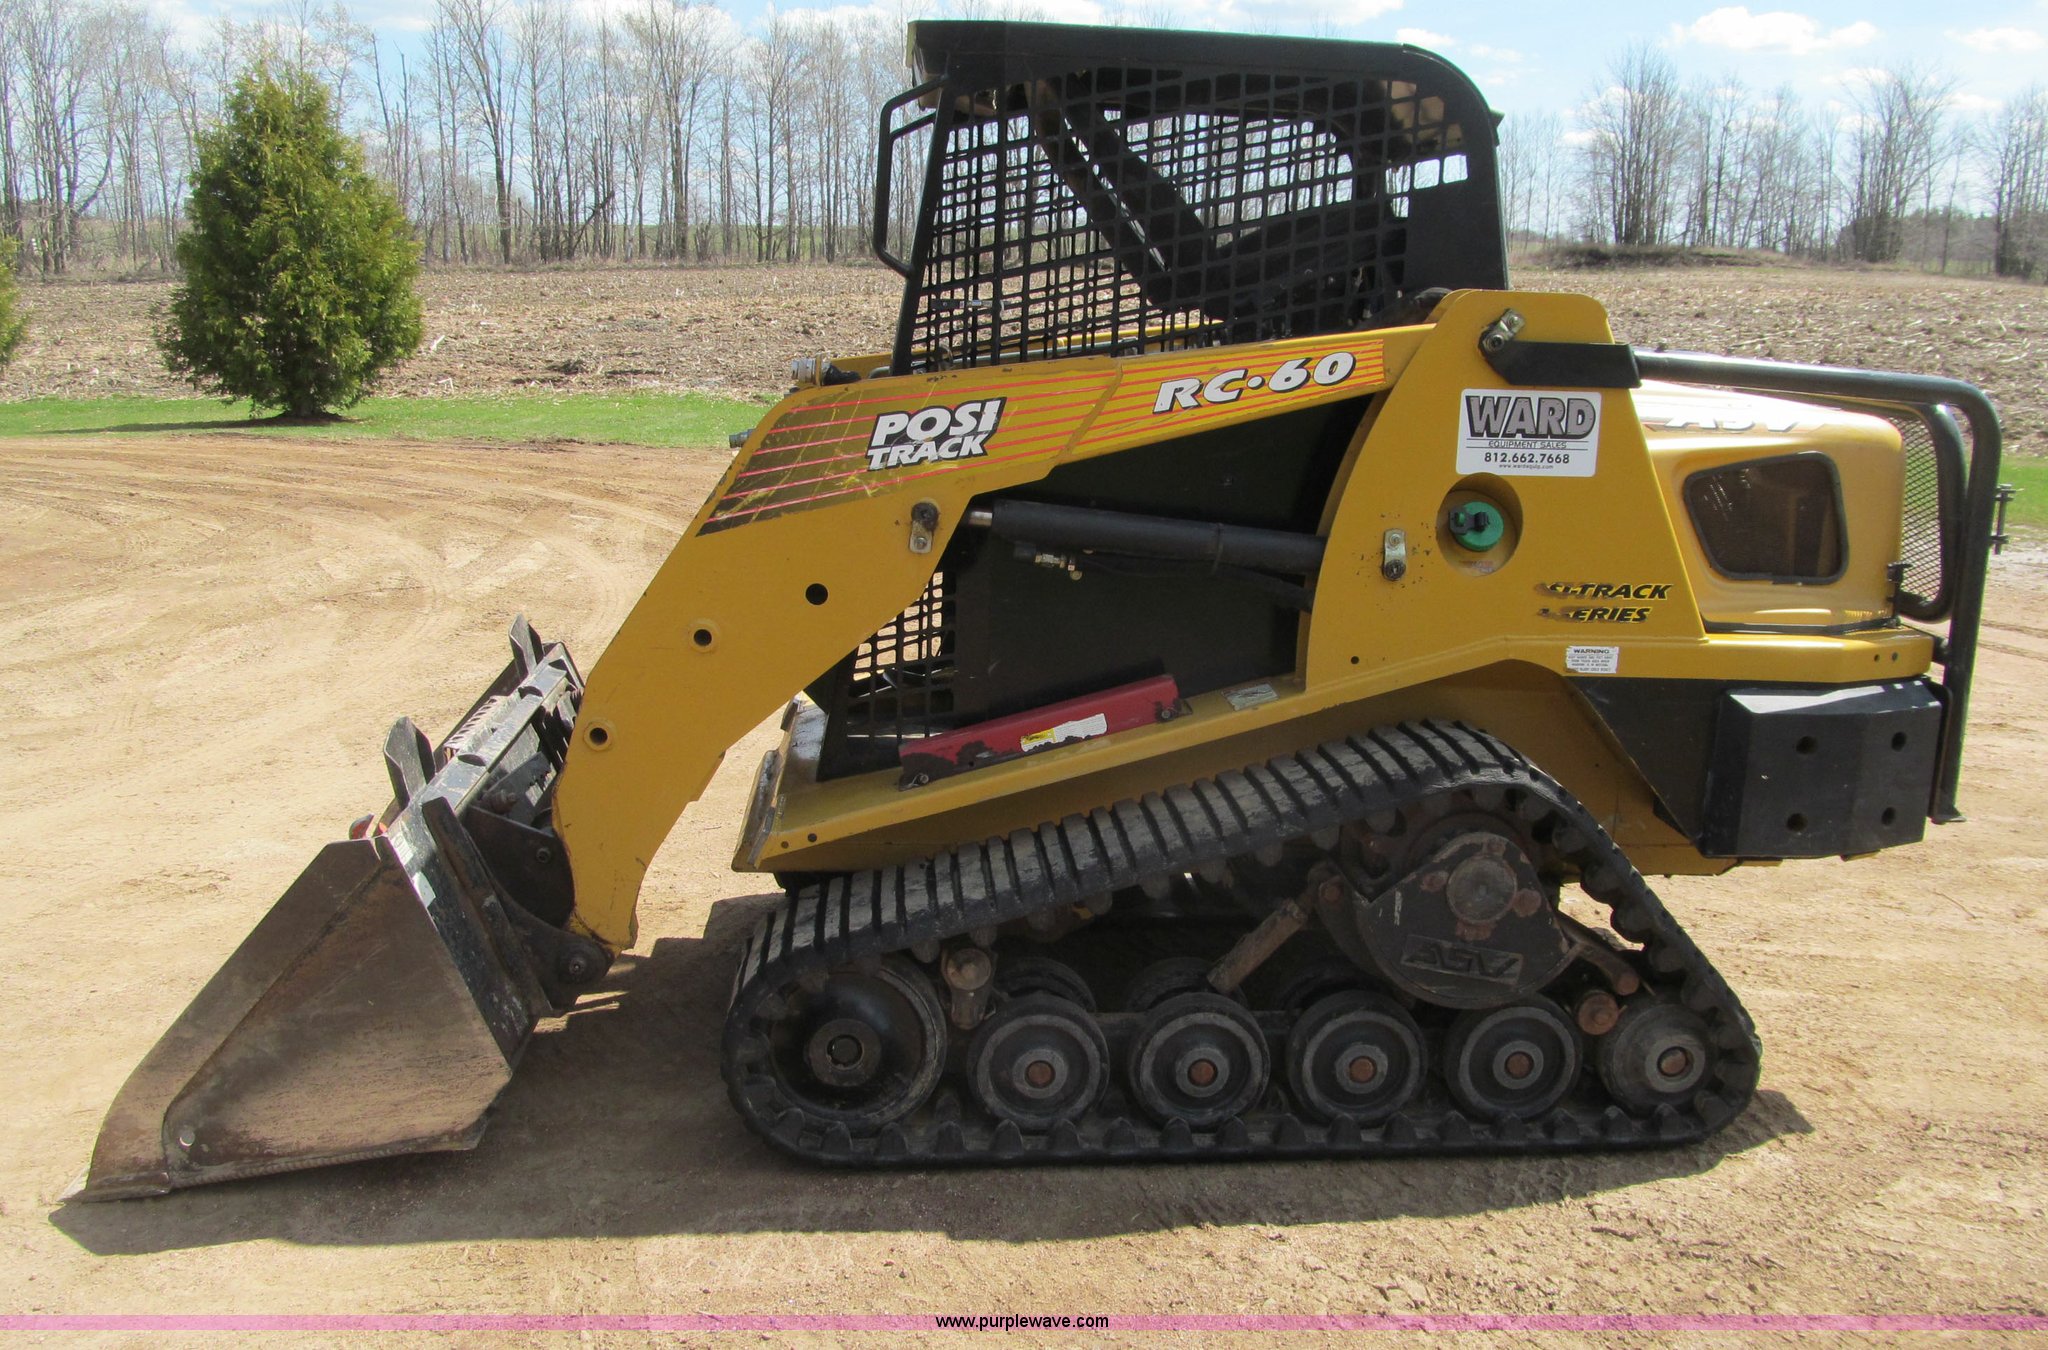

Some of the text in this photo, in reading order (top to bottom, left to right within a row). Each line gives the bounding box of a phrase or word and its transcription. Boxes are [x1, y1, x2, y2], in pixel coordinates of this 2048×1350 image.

[870, 398, 1005, 447] POSI
[1465, 395, 1596, 439] WARD
[866, 433, 988, 471] TRACK
[1484, 452, 1570, 464] 812.662.7668
[1488, 440, 1567, 450] EQUIPMENT SALES
